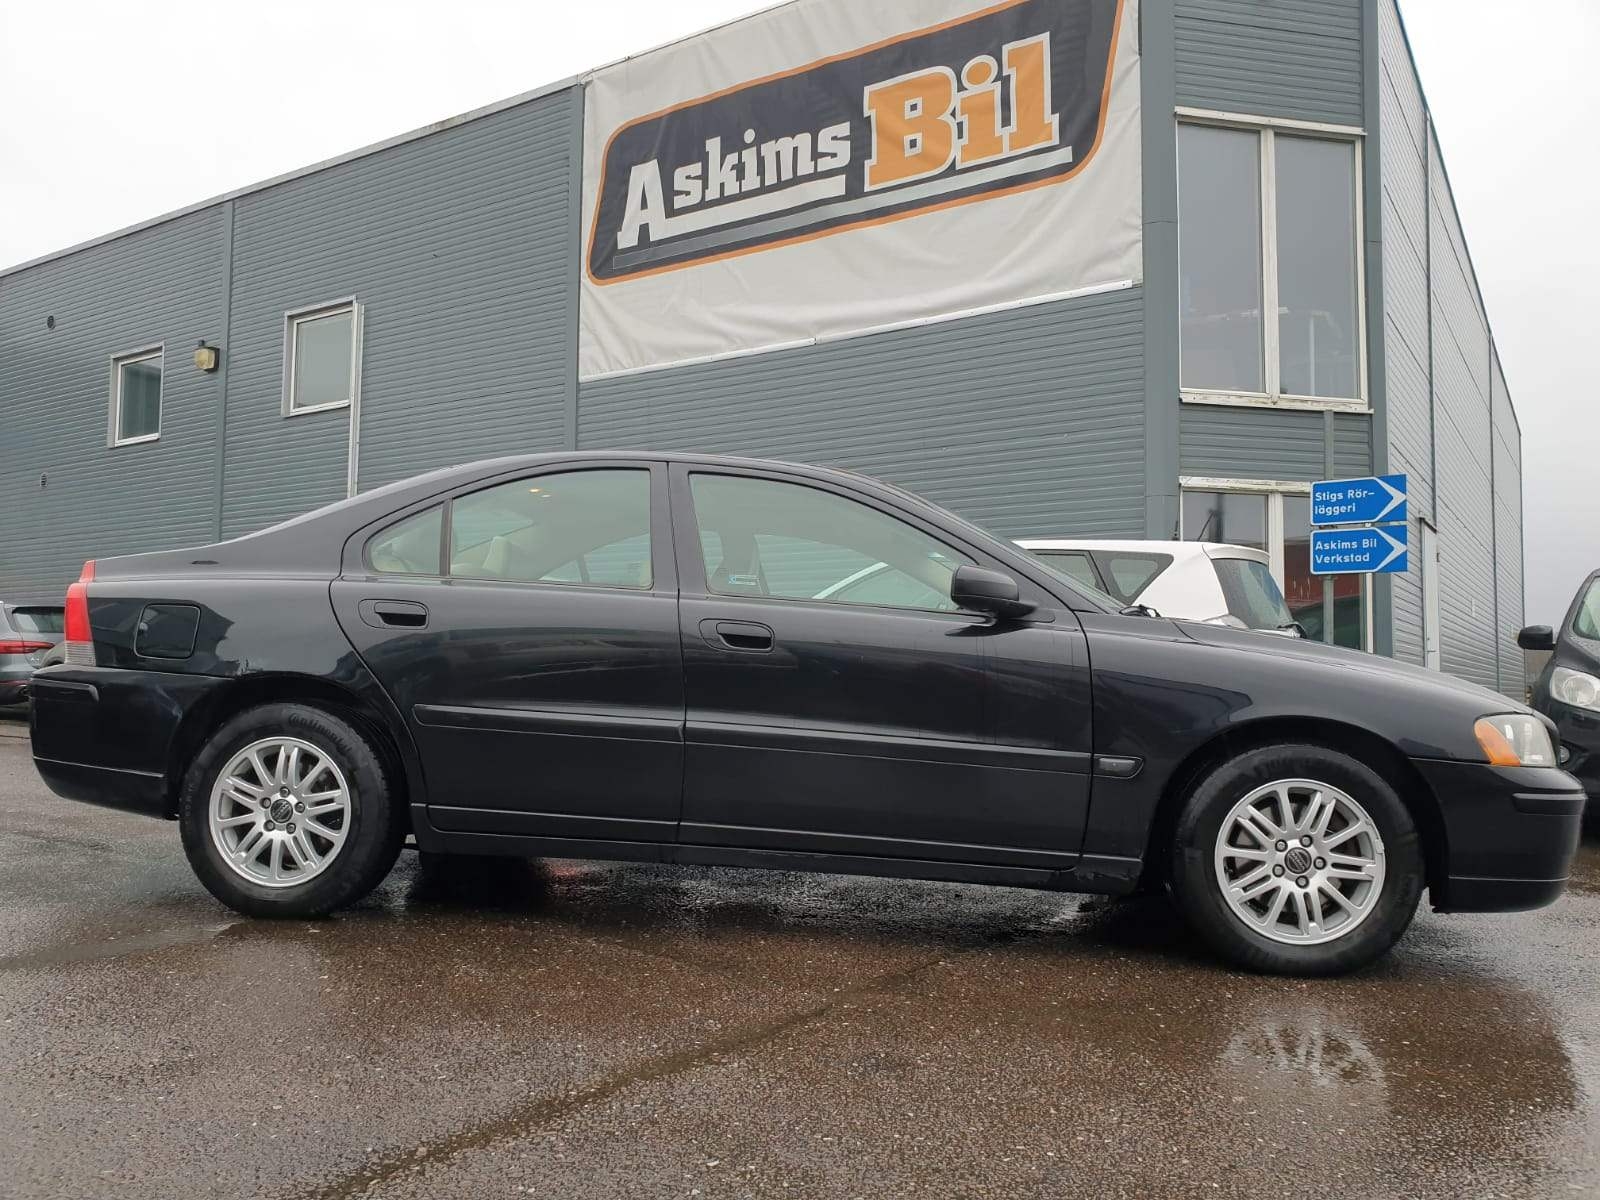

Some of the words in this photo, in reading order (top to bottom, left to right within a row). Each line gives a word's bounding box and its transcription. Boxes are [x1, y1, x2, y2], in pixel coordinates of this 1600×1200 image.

[617, 120, 850, 249] Askims
[863, 31, 1060, 192] Bil
[1315, 490, 1344, 503] Stigs
[1347, 488, 1375, 499] Rör-
[1314, 502, 1356, 516] läggeri
[1315, 540, 1358, 551] Askims
[1362, 538, 1377, 549] Bil
[1314, 552, 1370, 564] Verkstad
